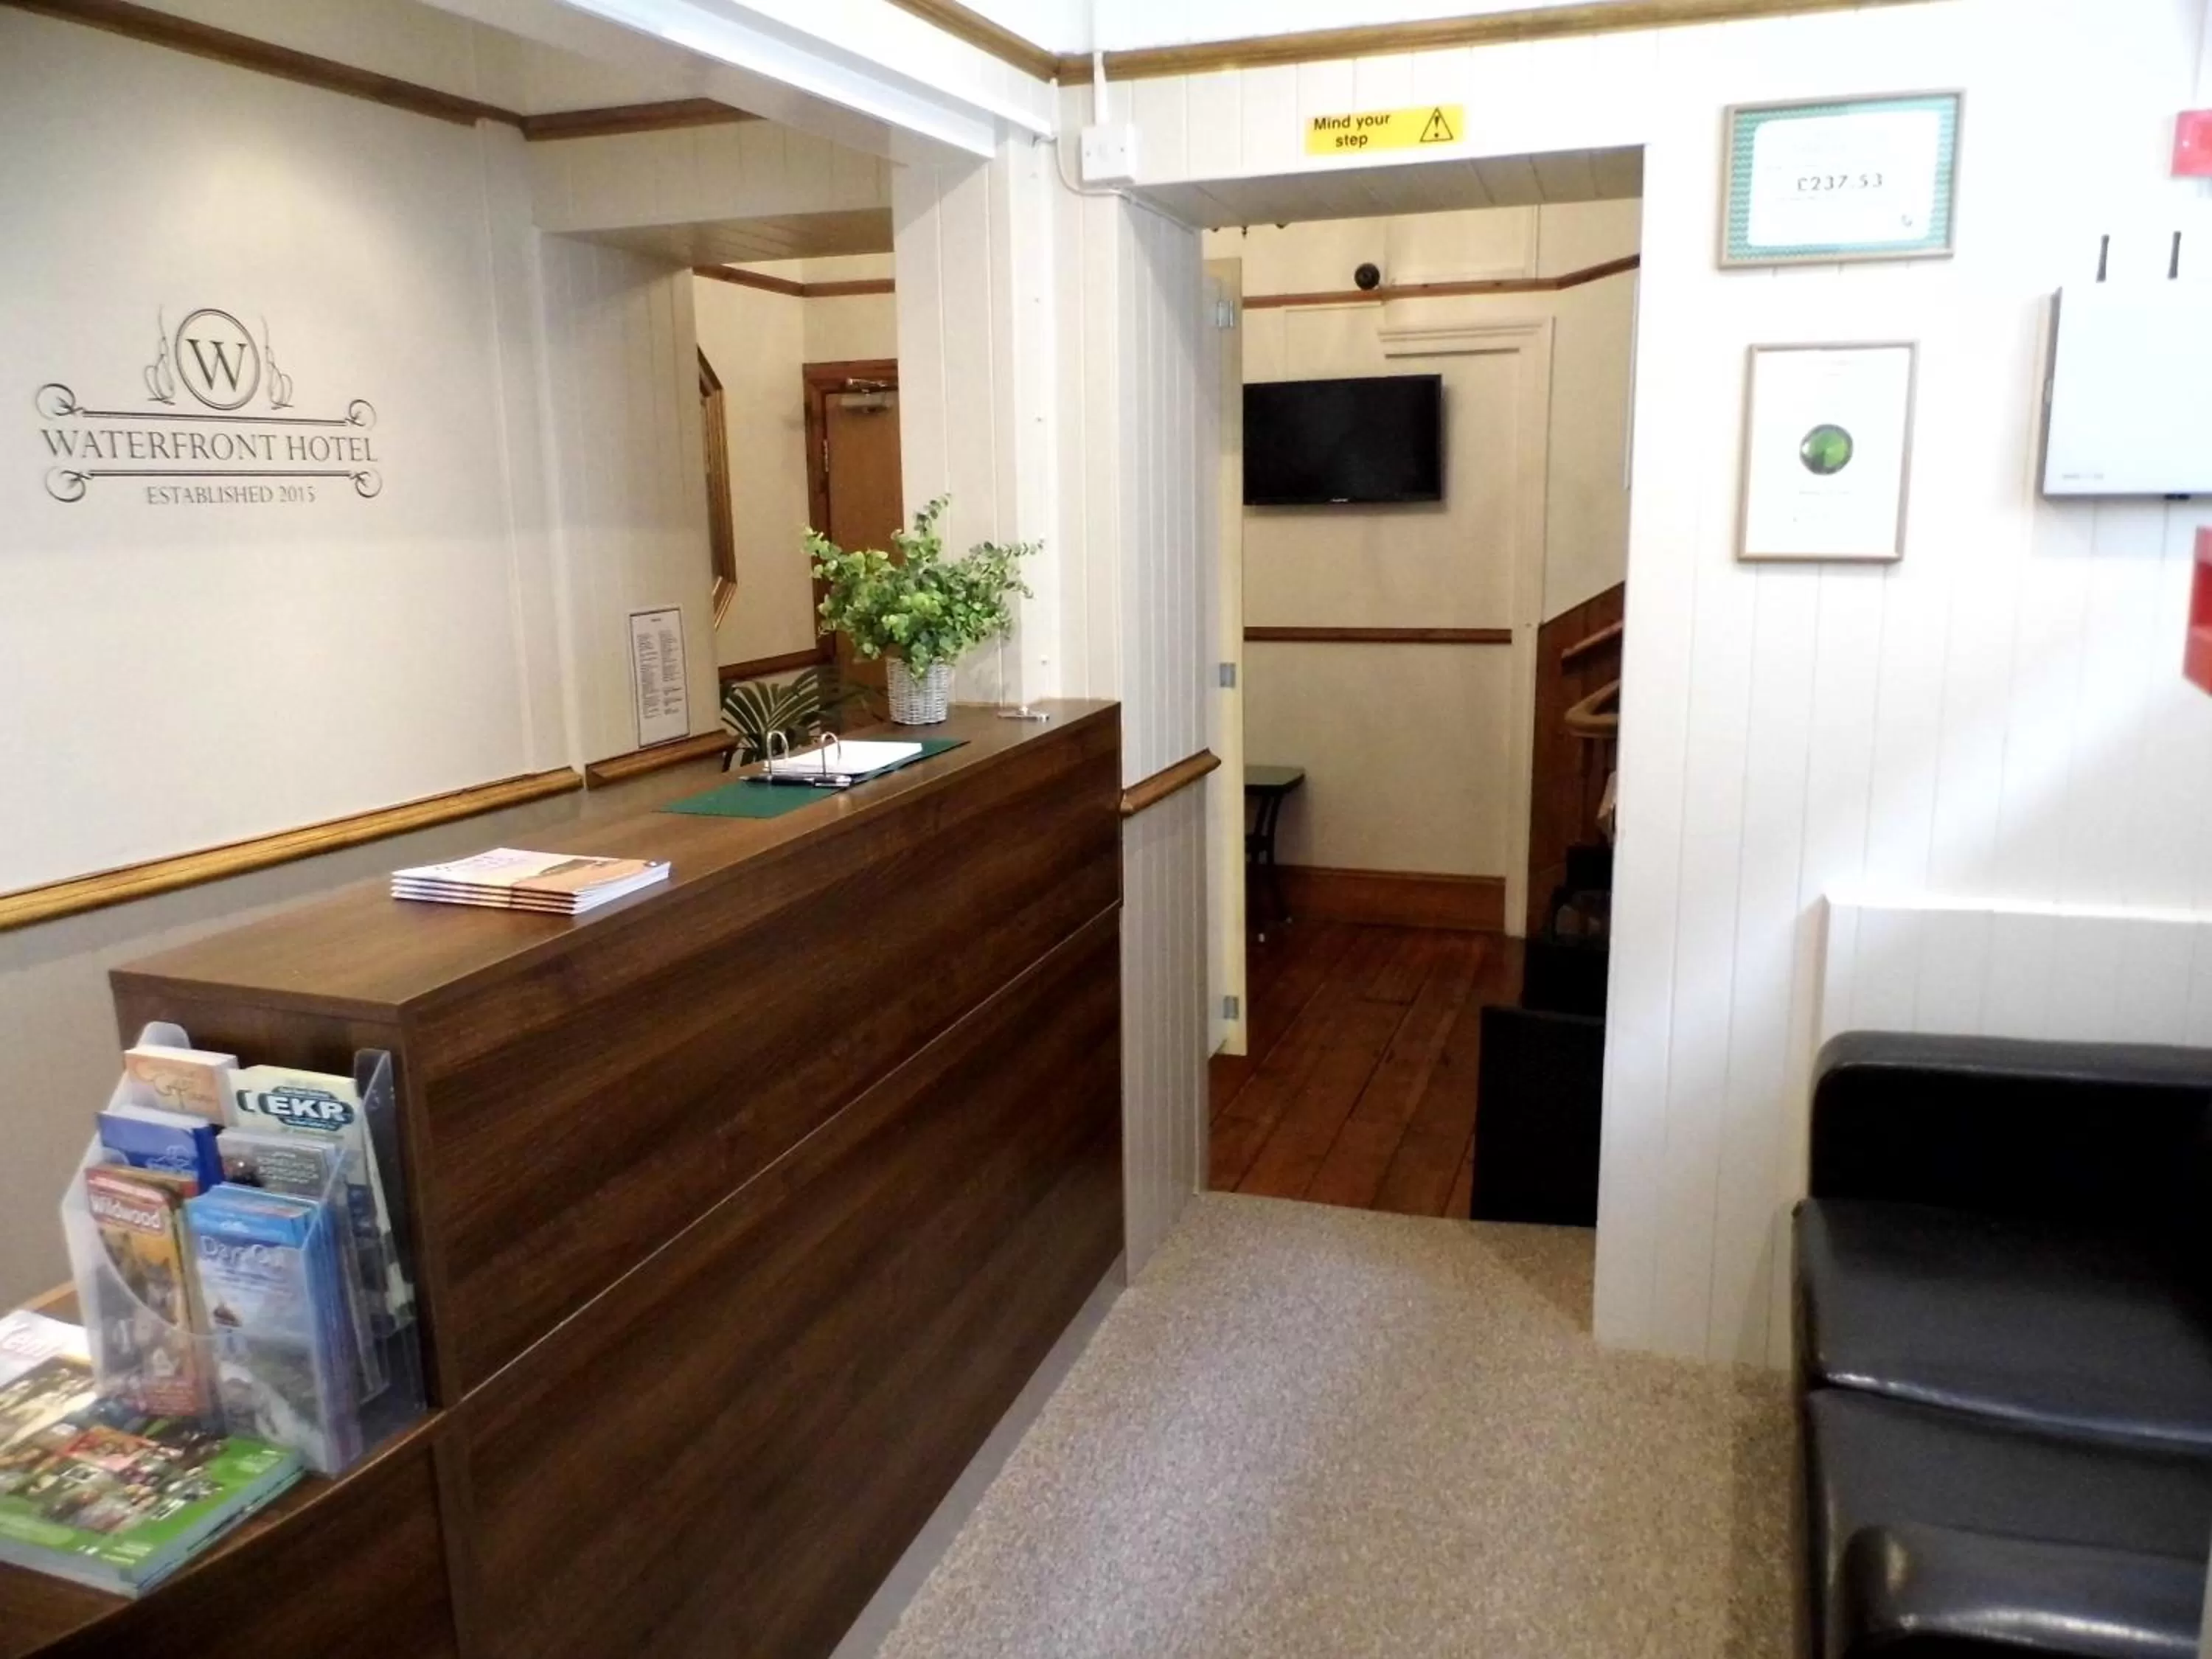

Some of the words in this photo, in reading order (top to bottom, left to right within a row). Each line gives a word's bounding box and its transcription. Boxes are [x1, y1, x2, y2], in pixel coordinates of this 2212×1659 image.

[1313, 114, 1351, 131] Mind
[1356, 114, 1390, 131] your
[1335, 134, 1368, 148] step
[186, 338, 248, 391] W
[41, 428, 277, 461] WATERFRONT
[287, 435, 378, 462] HOTEL
[147, 486, 274, 504] ESTABLISHED
[279, 486, 316, 503] 2015
[266, 1095, 346, 1121] EKR
[90, 1194, 161, 1229] Wildwood
